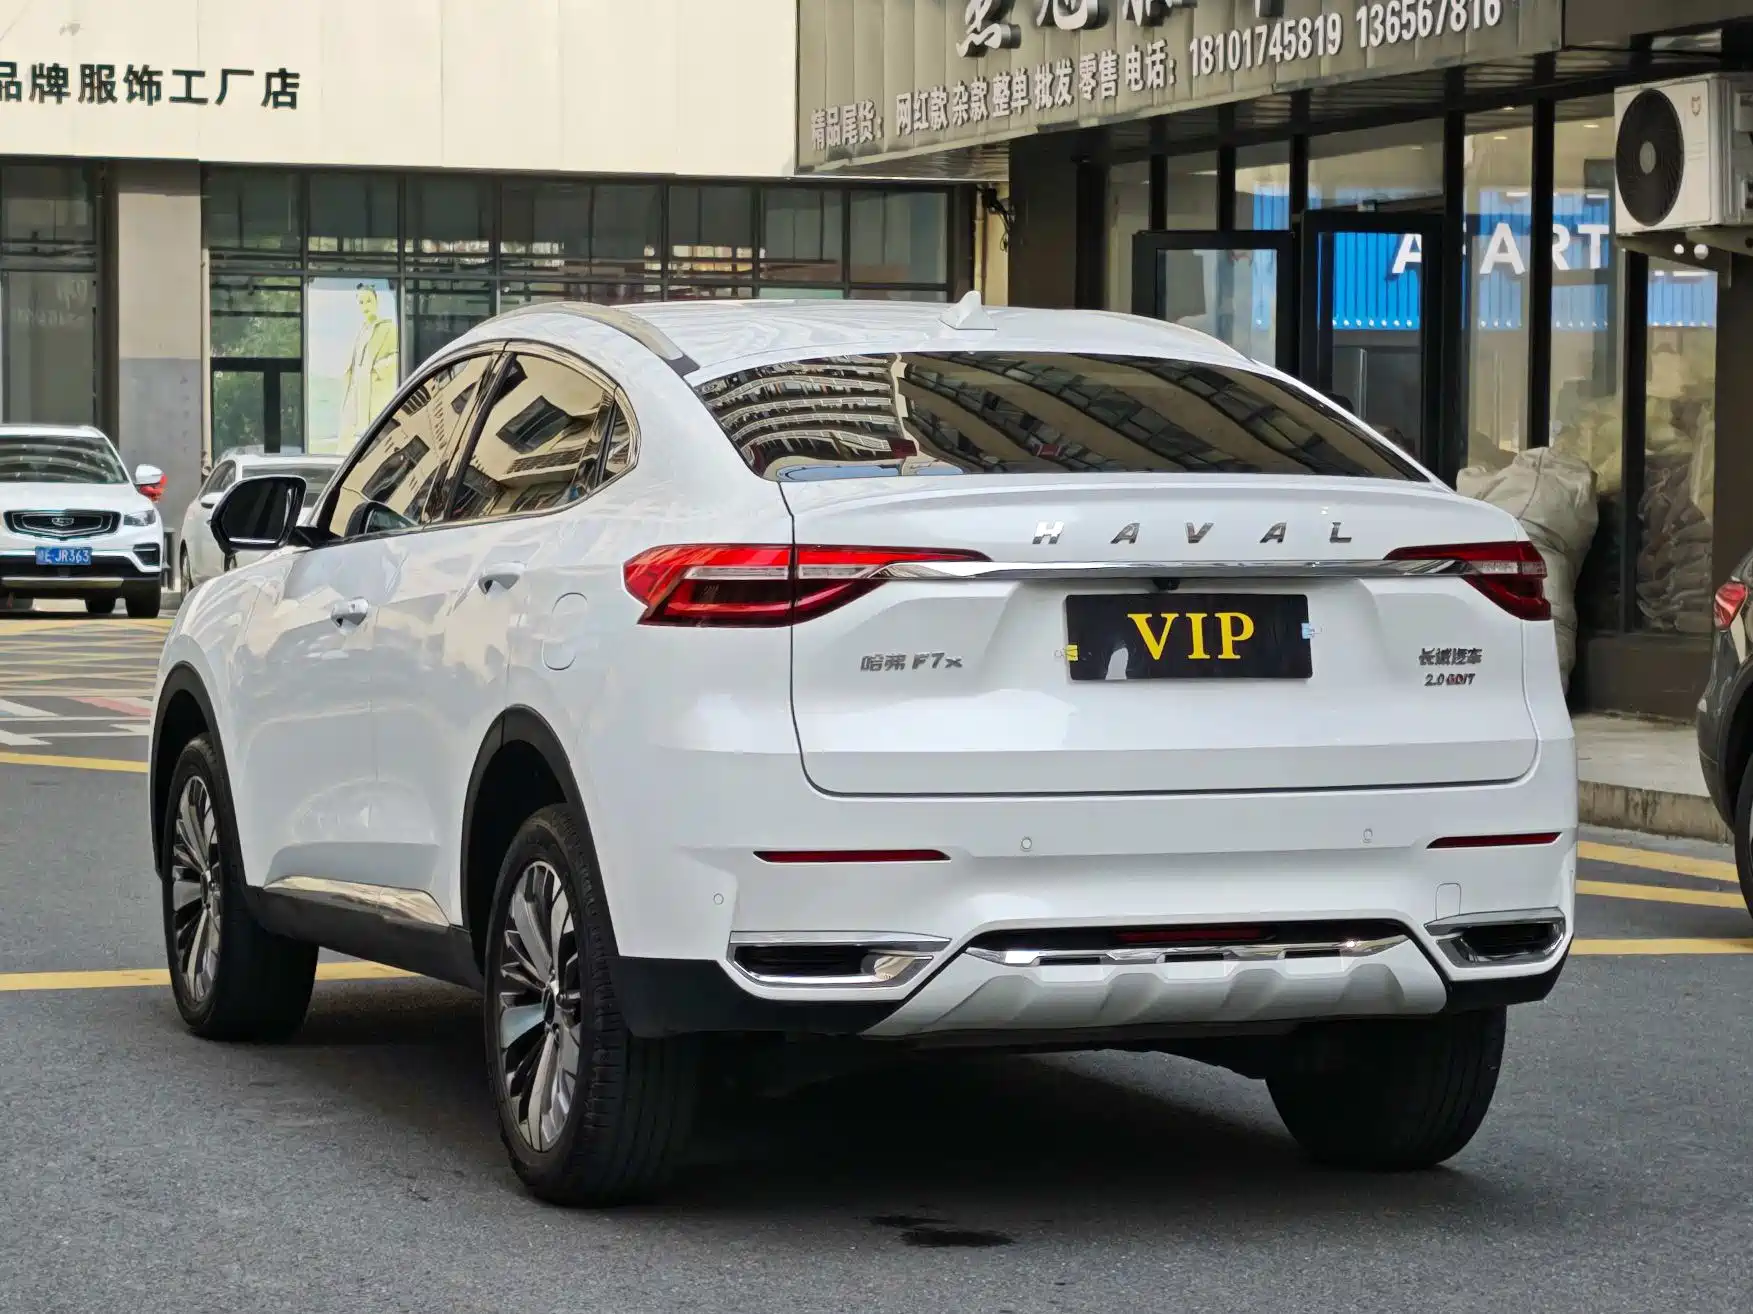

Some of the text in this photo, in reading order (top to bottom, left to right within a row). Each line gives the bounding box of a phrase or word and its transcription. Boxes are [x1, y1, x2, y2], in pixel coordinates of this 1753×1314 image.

[0, 61, 301, 110] 品牌服饰工厂店
[896, 86, 949, 136] 网红款
[952, 76, 989, 126] 杂款
[992, 67, 1030, 118] 整单
[1034, 58, 1074, 110] 批发
[1078, 50, 1118, 100] 零售
[1189, 12, 1343, 77] 18101745819
[1032, 521, 1352, 545] HAVAL
[1127, 612, 1255, 660] VIP
[860, 652, 963, 672] 哈弗 F7x
